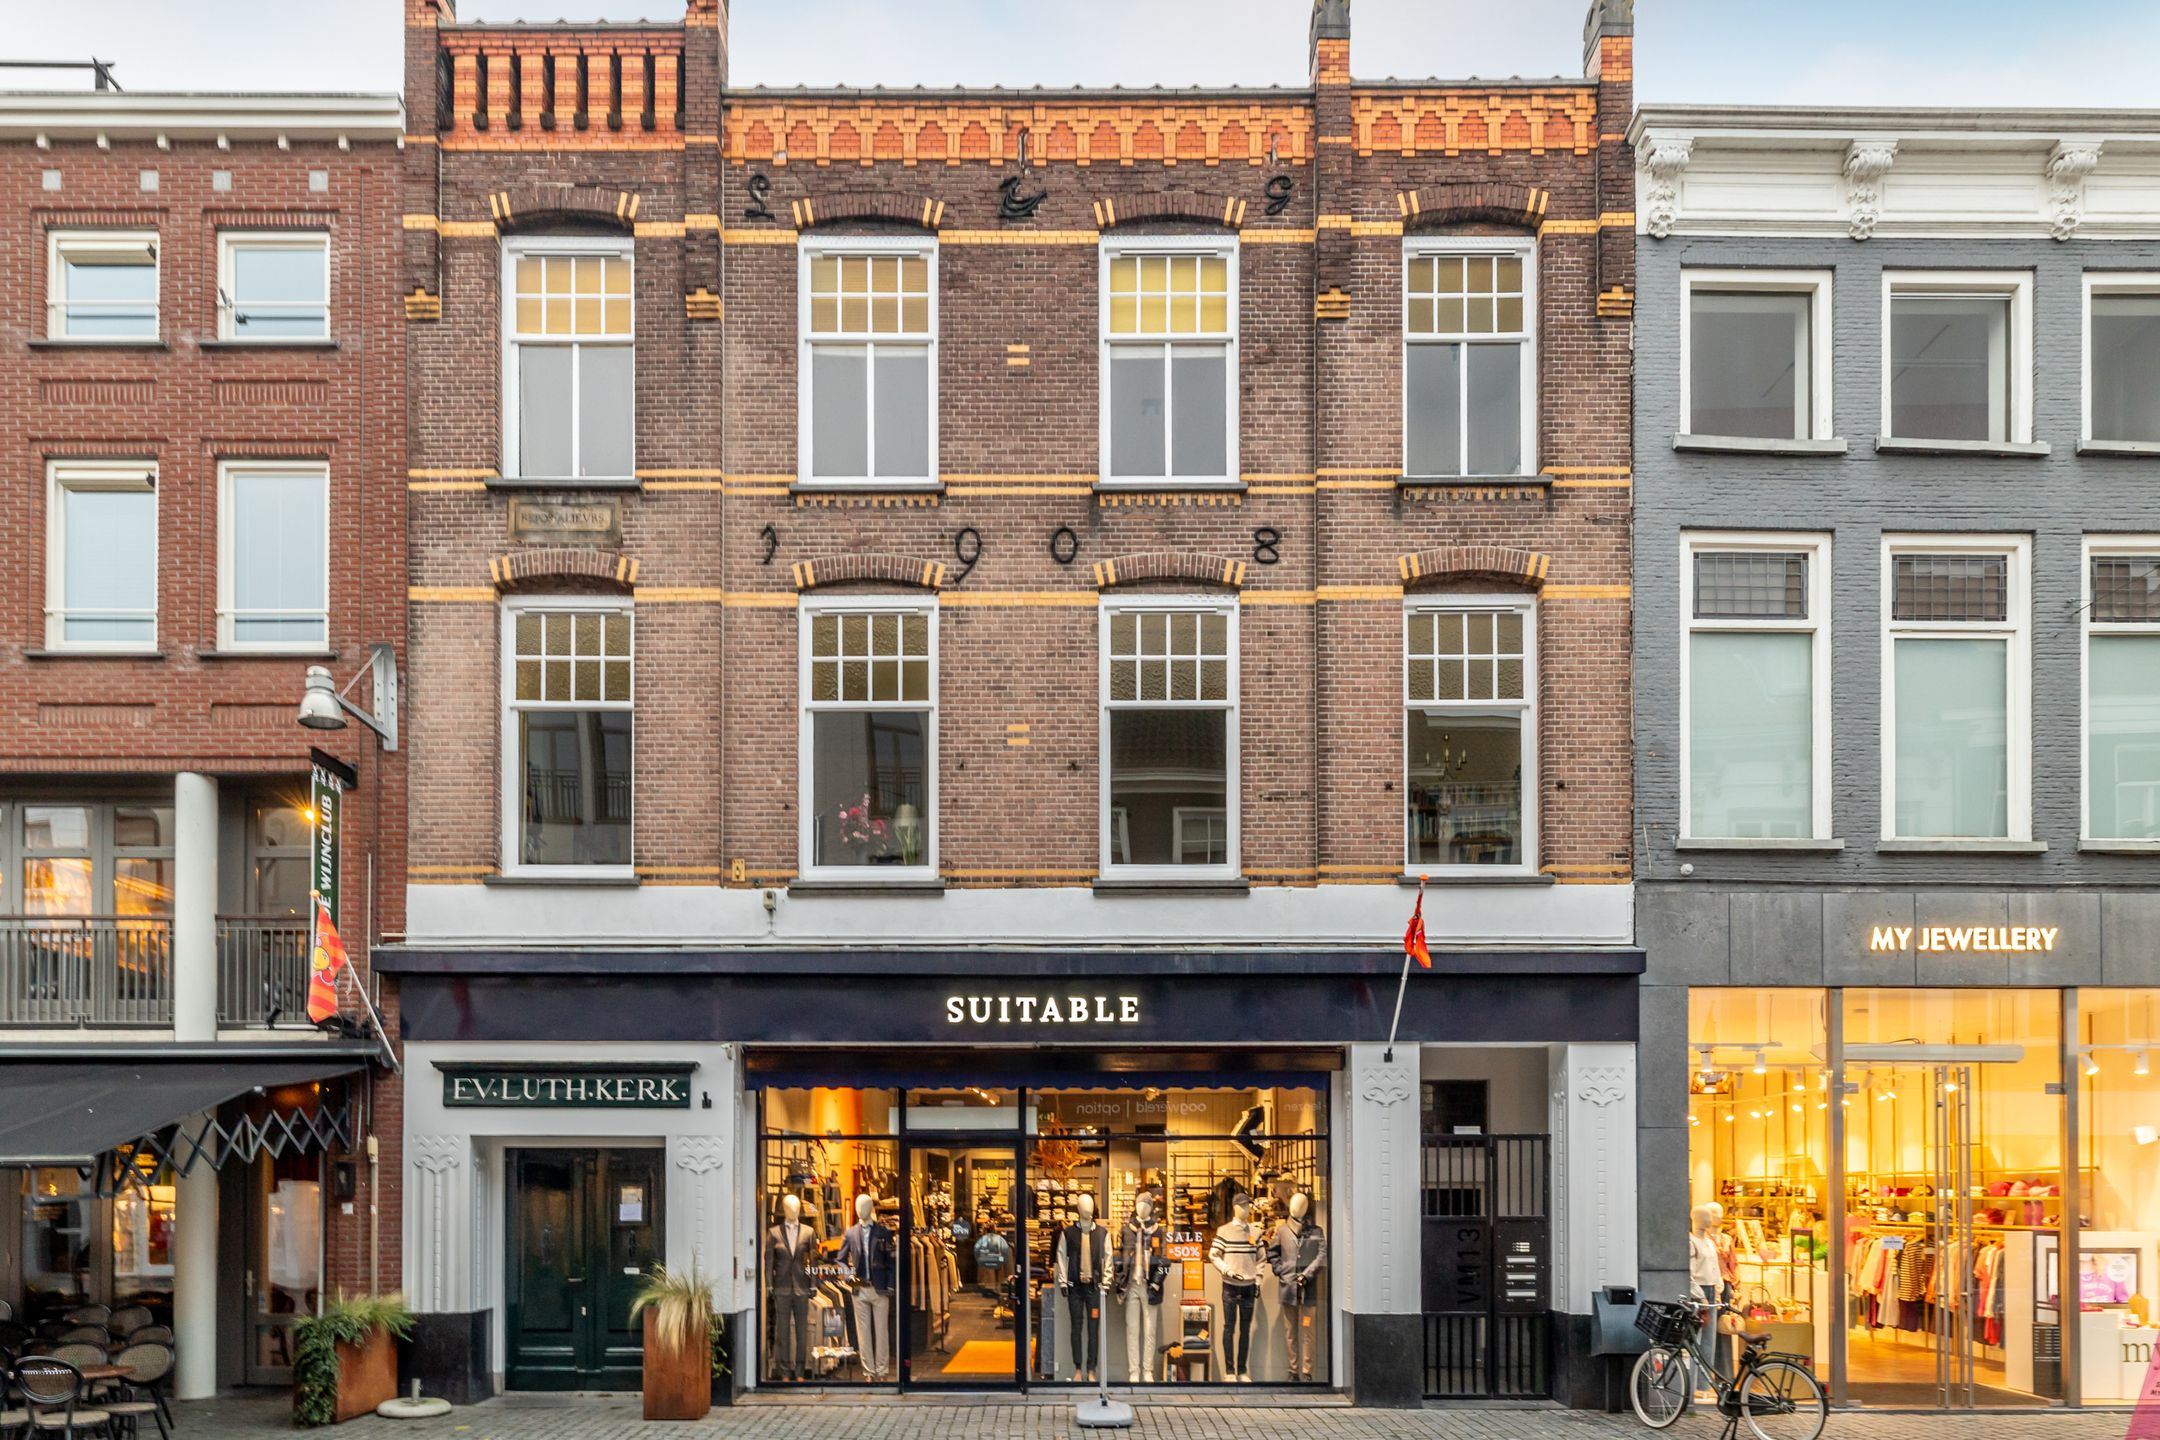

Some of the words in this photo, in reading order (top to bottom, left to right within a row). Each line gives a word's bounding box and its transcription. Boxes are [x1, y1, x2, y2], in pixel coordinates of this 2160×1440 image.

[320, 794, 332, 890] WIJNCLUB
[1870, 926, 1913, 951] MY
[1917, 927, 2059, 951] JEWELLERY
[946, 996, 1140, 1024] SUITABLE
[1166, 1231, 1203, 1243] SALE
